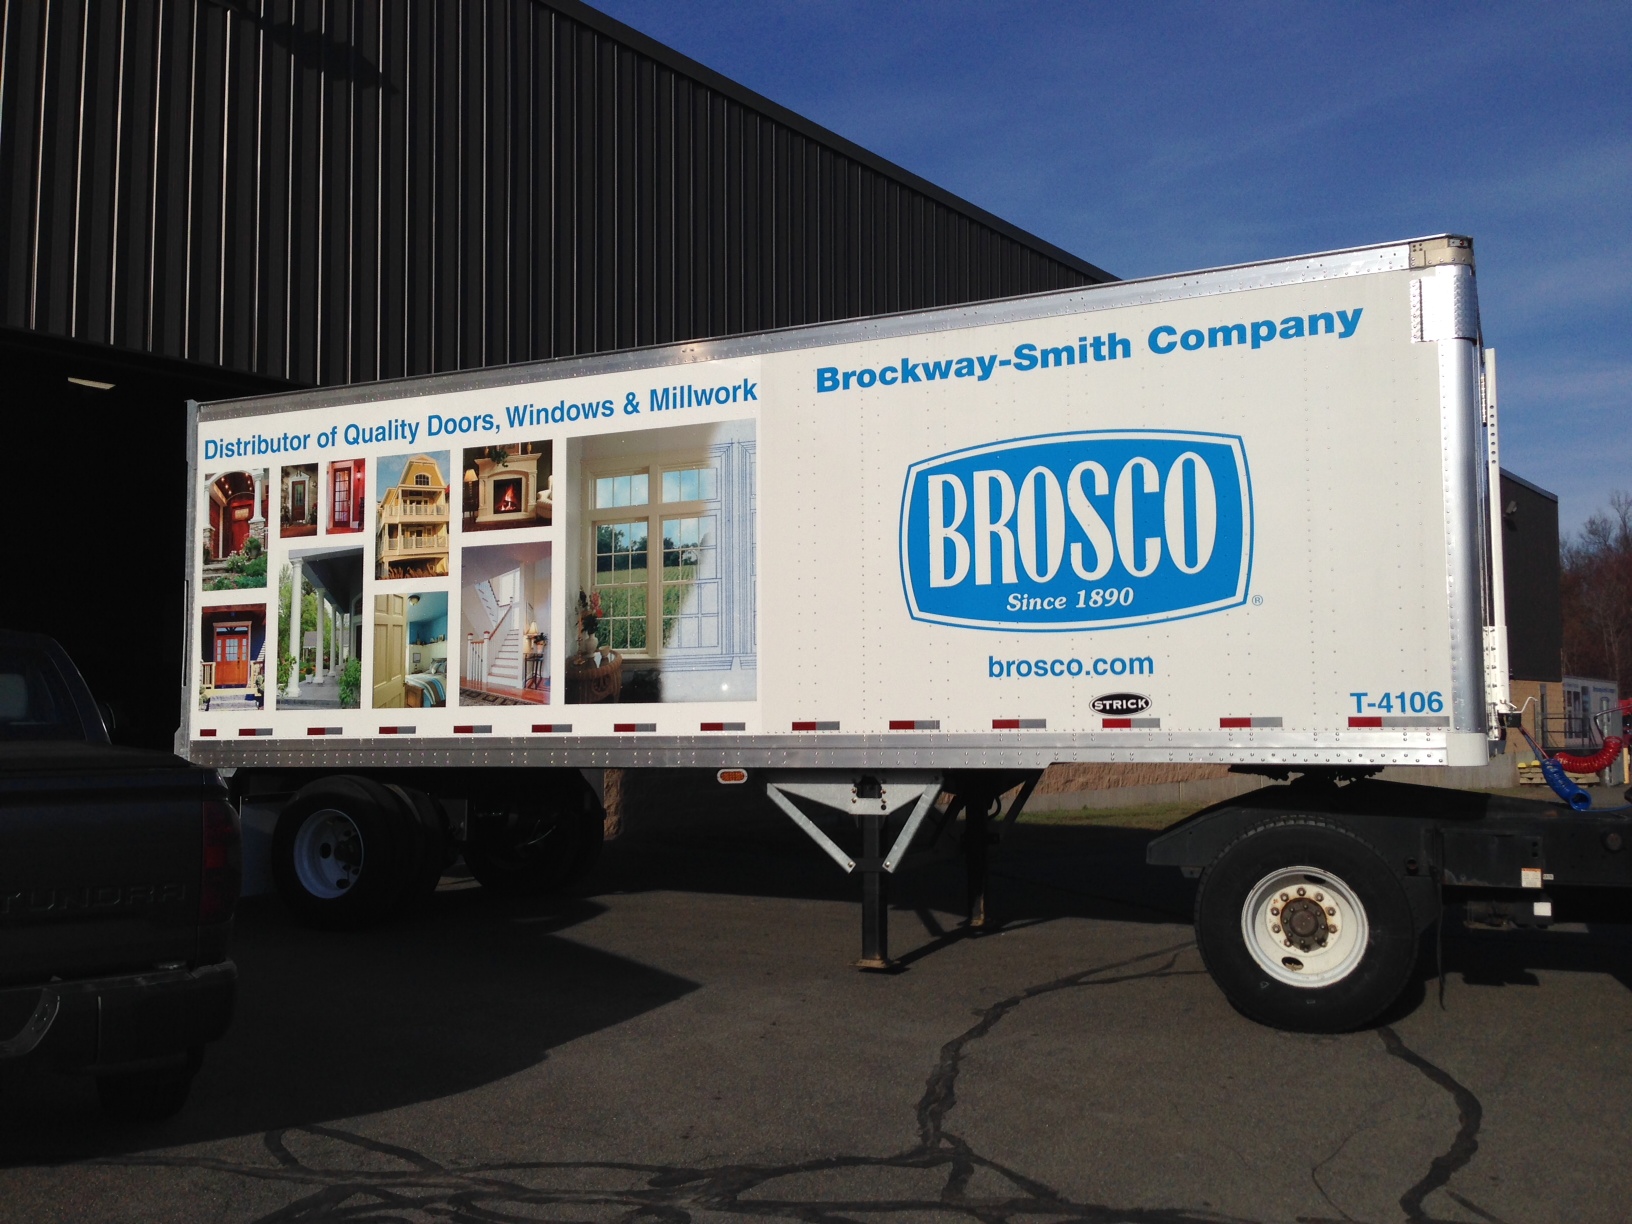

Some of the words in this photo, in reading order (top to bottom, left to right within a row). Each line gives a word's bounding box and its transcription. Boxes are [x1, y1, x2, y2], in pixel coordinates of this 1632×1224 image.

[816, 332, 1131, 393] Brockway-Smith
[1148, 307, 1364, 355] Company
[204, 433, 311, 460] Distributor
[317, 426, 338, 449] of
[344, 415, 421, 445] Quality
[428, 413, 501, 437] Doors,
[506, 399, 615, 428] Windows
[623, 391, 640, 416] &
[650, 378, 758, 412] Millwork
[927, 450, 1217, 588] BROSCO
[1006, 593, 1067, 611] Since
[1076, 586, 1134, 608] 1890
[988, 654, 1155, 679] brosco.com
[1094, 698, 1147, 710] STRICK
[1350, 691, 1444, 714] T-4106
[0, 882, 186, 915] TUNDRA
